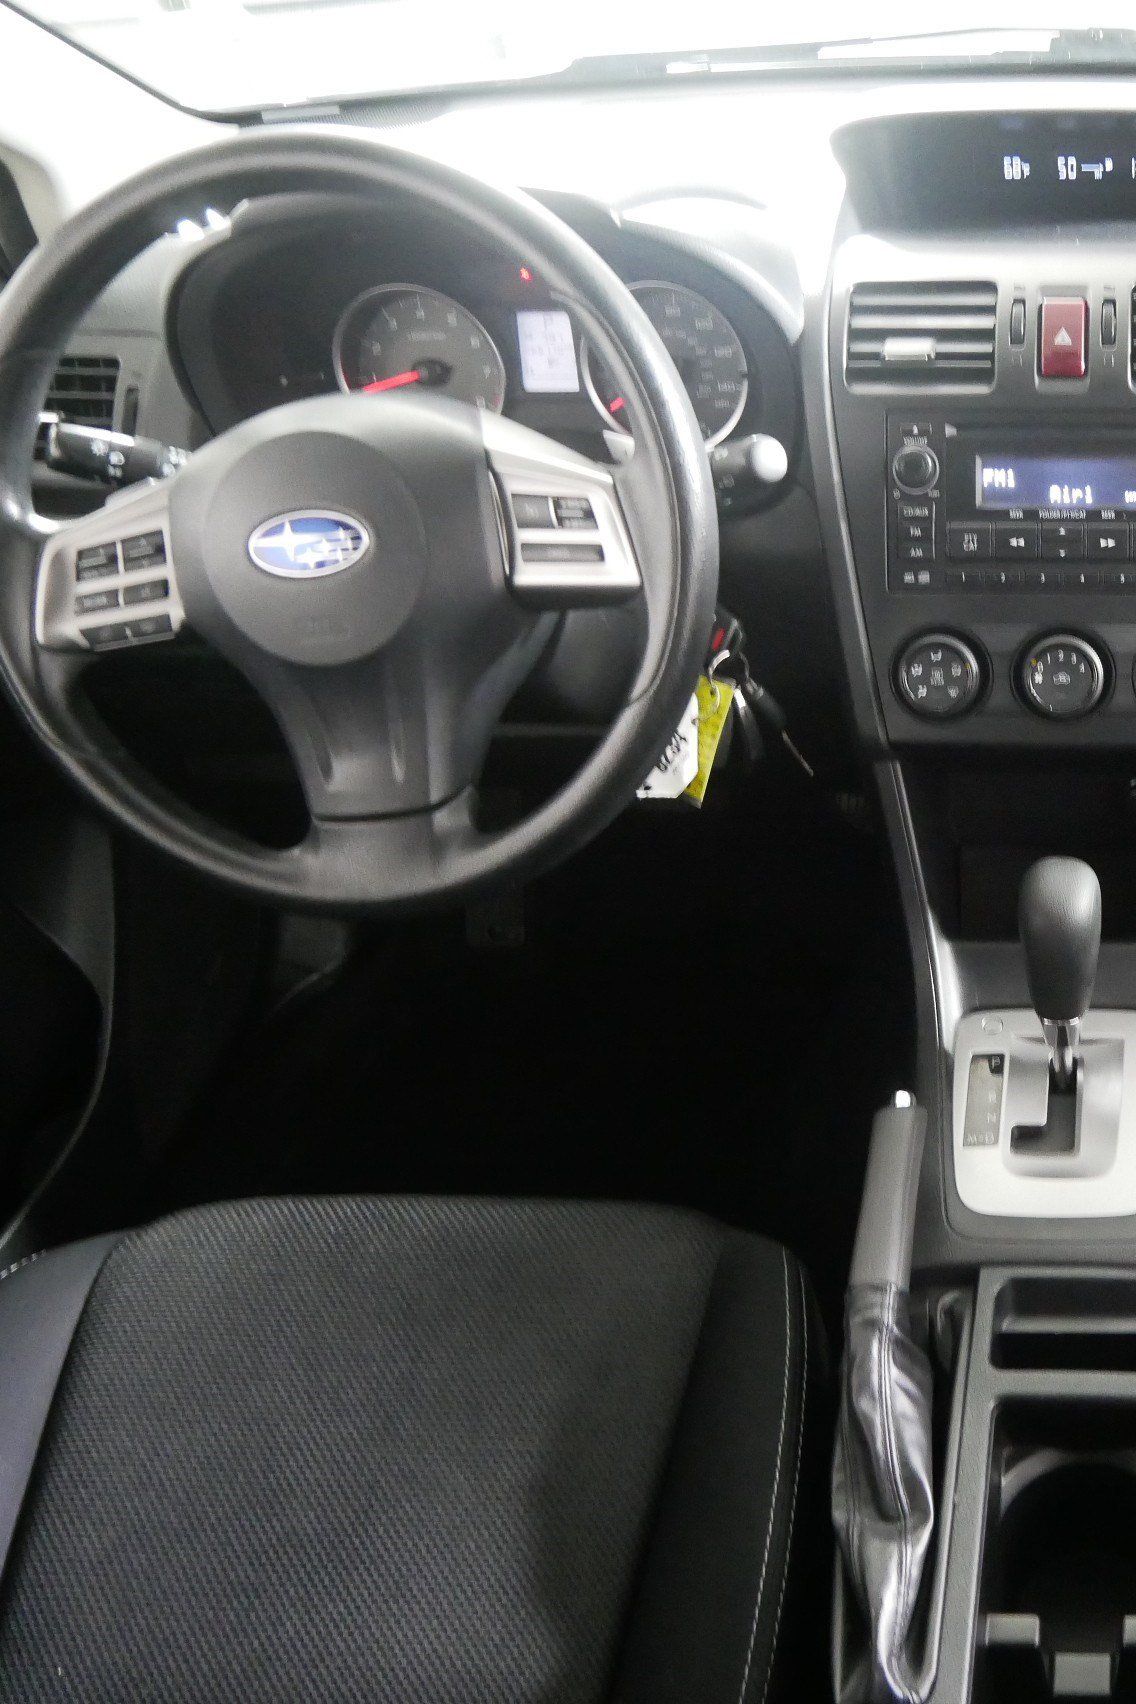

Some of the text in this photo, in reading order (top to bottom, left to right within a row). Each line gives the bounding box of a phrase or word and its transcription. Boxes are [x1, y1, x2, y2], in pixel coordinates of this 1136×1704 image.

[982, 467, 1015, 488] FM1
[909, 526, 922, 538] FM
[909, 547, 923, 558] AM
[991, 1055, 1001, 1069] P
[987, 1112, 997, 1124] N
